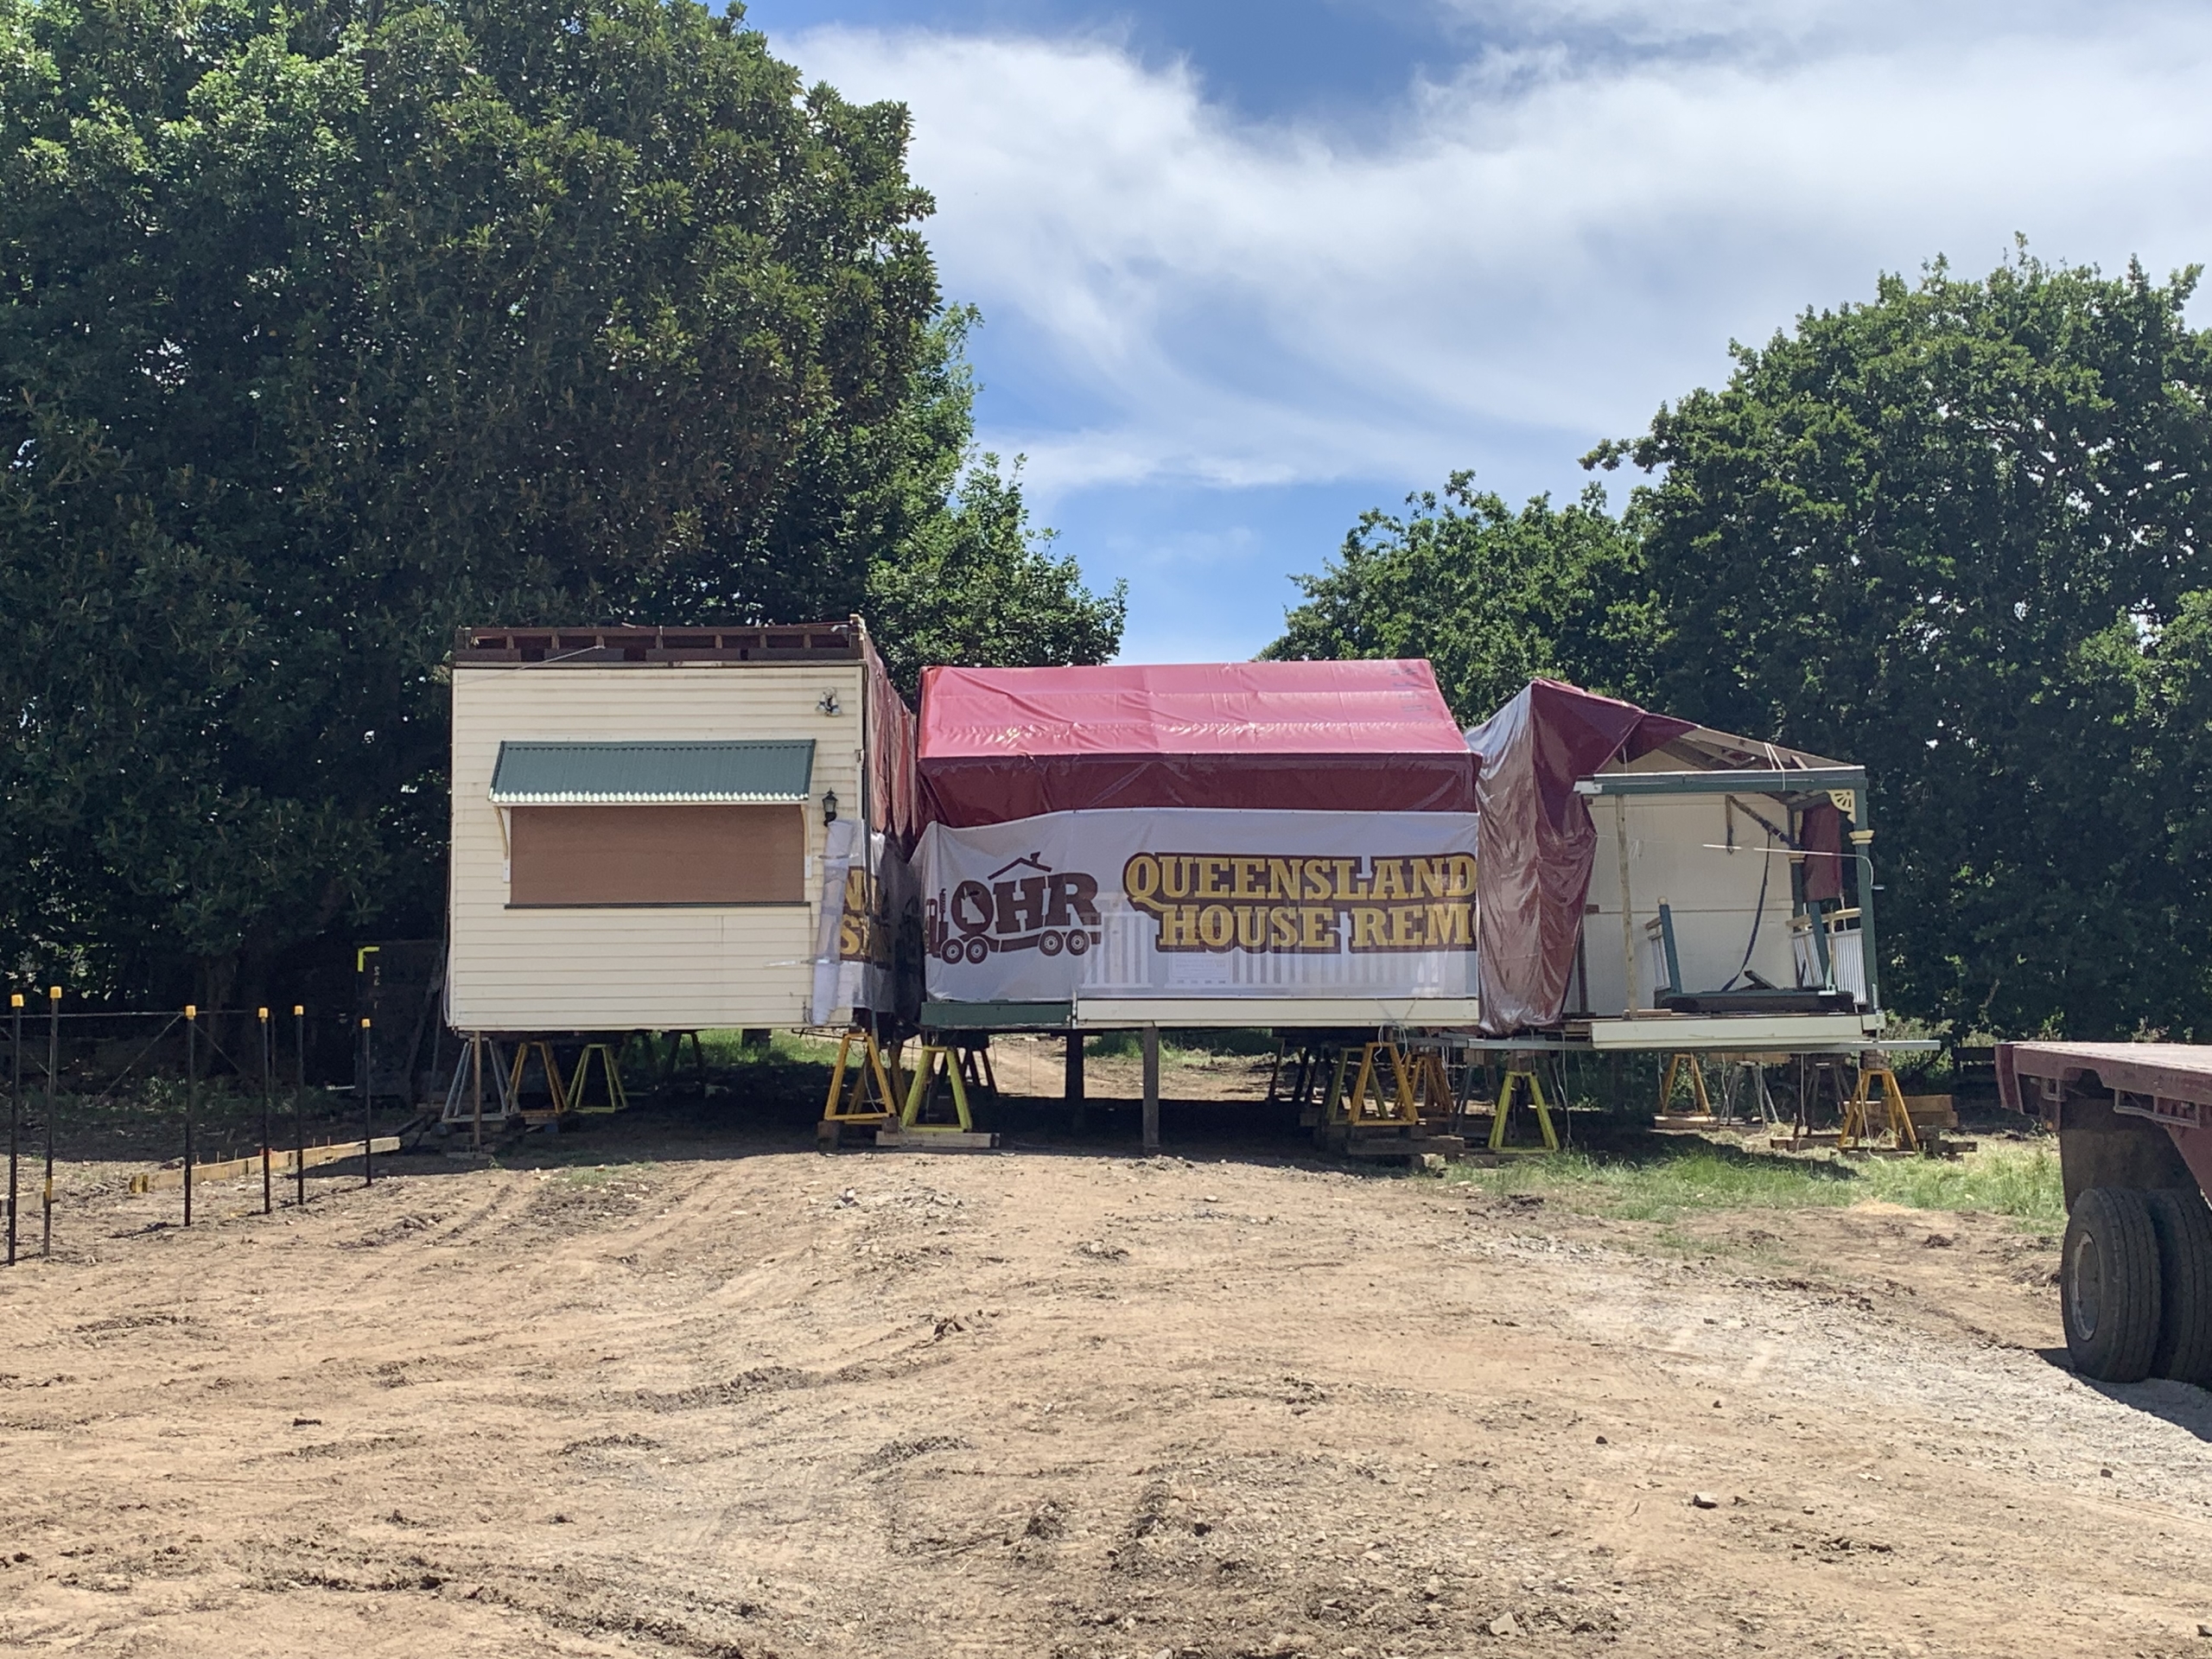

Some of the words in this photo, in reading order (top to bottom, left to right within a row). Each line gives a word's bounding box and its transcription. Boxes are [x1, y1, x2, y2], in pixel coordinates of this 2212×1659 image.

[1124, 852, 1478, 911] QUEENSLAND
[1158, 904, 1335, 949] HOUSE
[1351, 903, 1478, 947] REM
